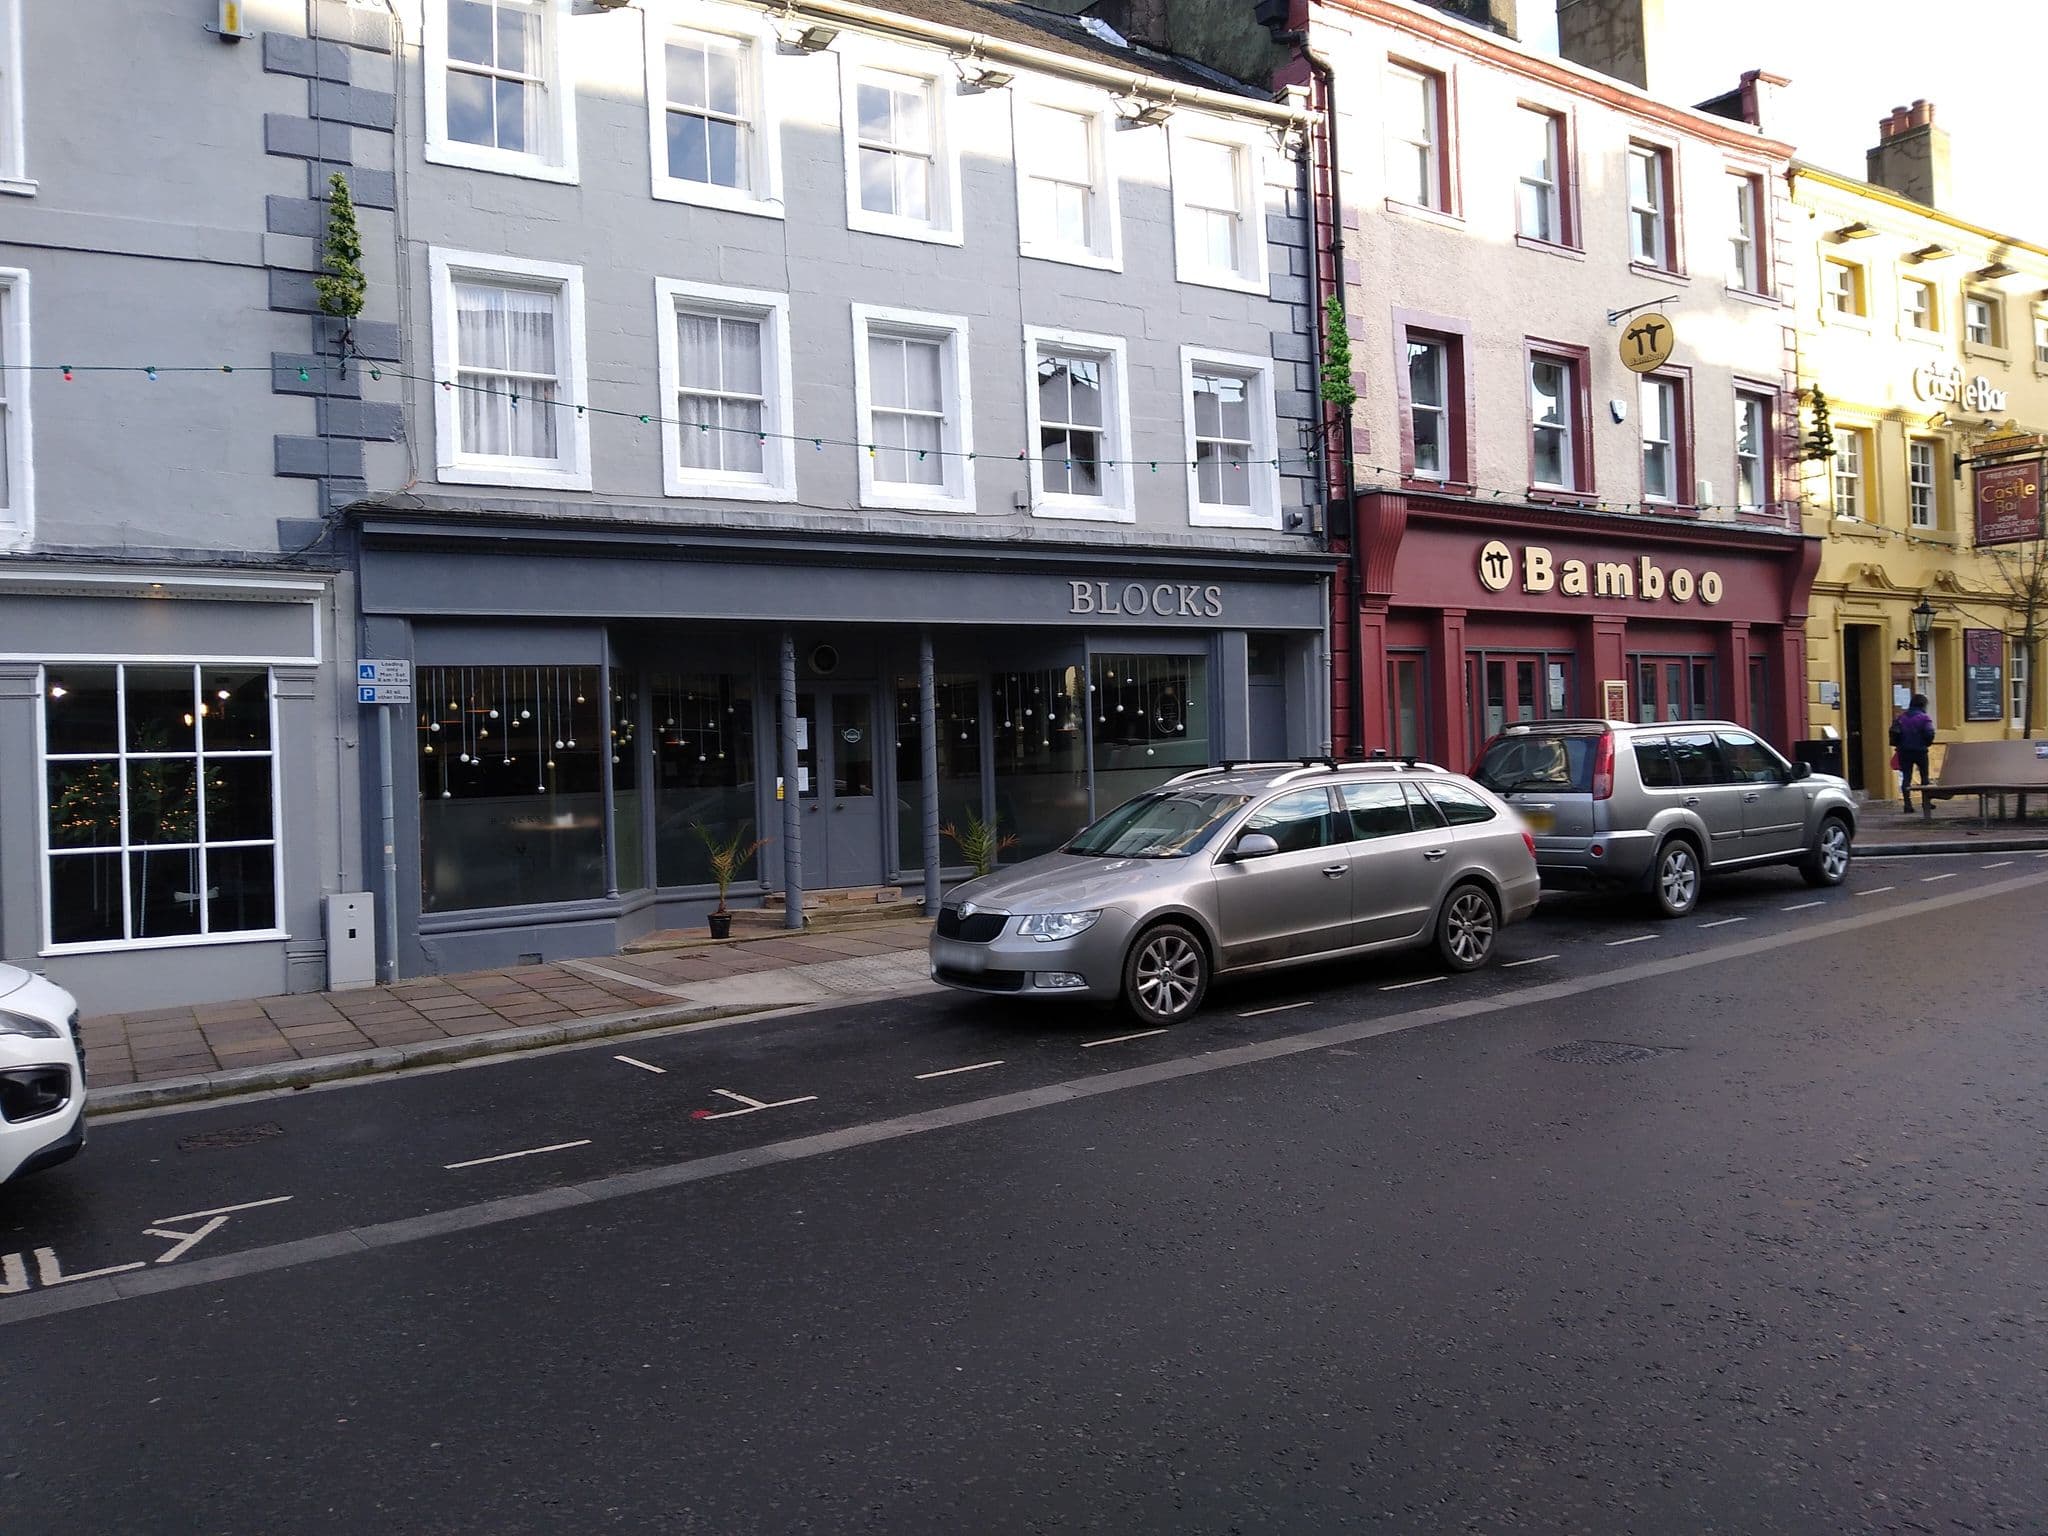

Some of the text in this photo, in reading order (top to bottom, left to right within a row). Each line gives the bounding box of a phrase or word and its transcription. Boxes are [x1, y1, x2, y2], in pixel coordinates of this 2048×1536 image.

[1975, 375, 2009, 412] Bar
[1981, 477, 2036, 503] Castle
[1995, 499, 2017, 514] Bar
[1522, 545, 1724, 606] Bamboo
[1068, 580, 1223, 617] BLOCKS
